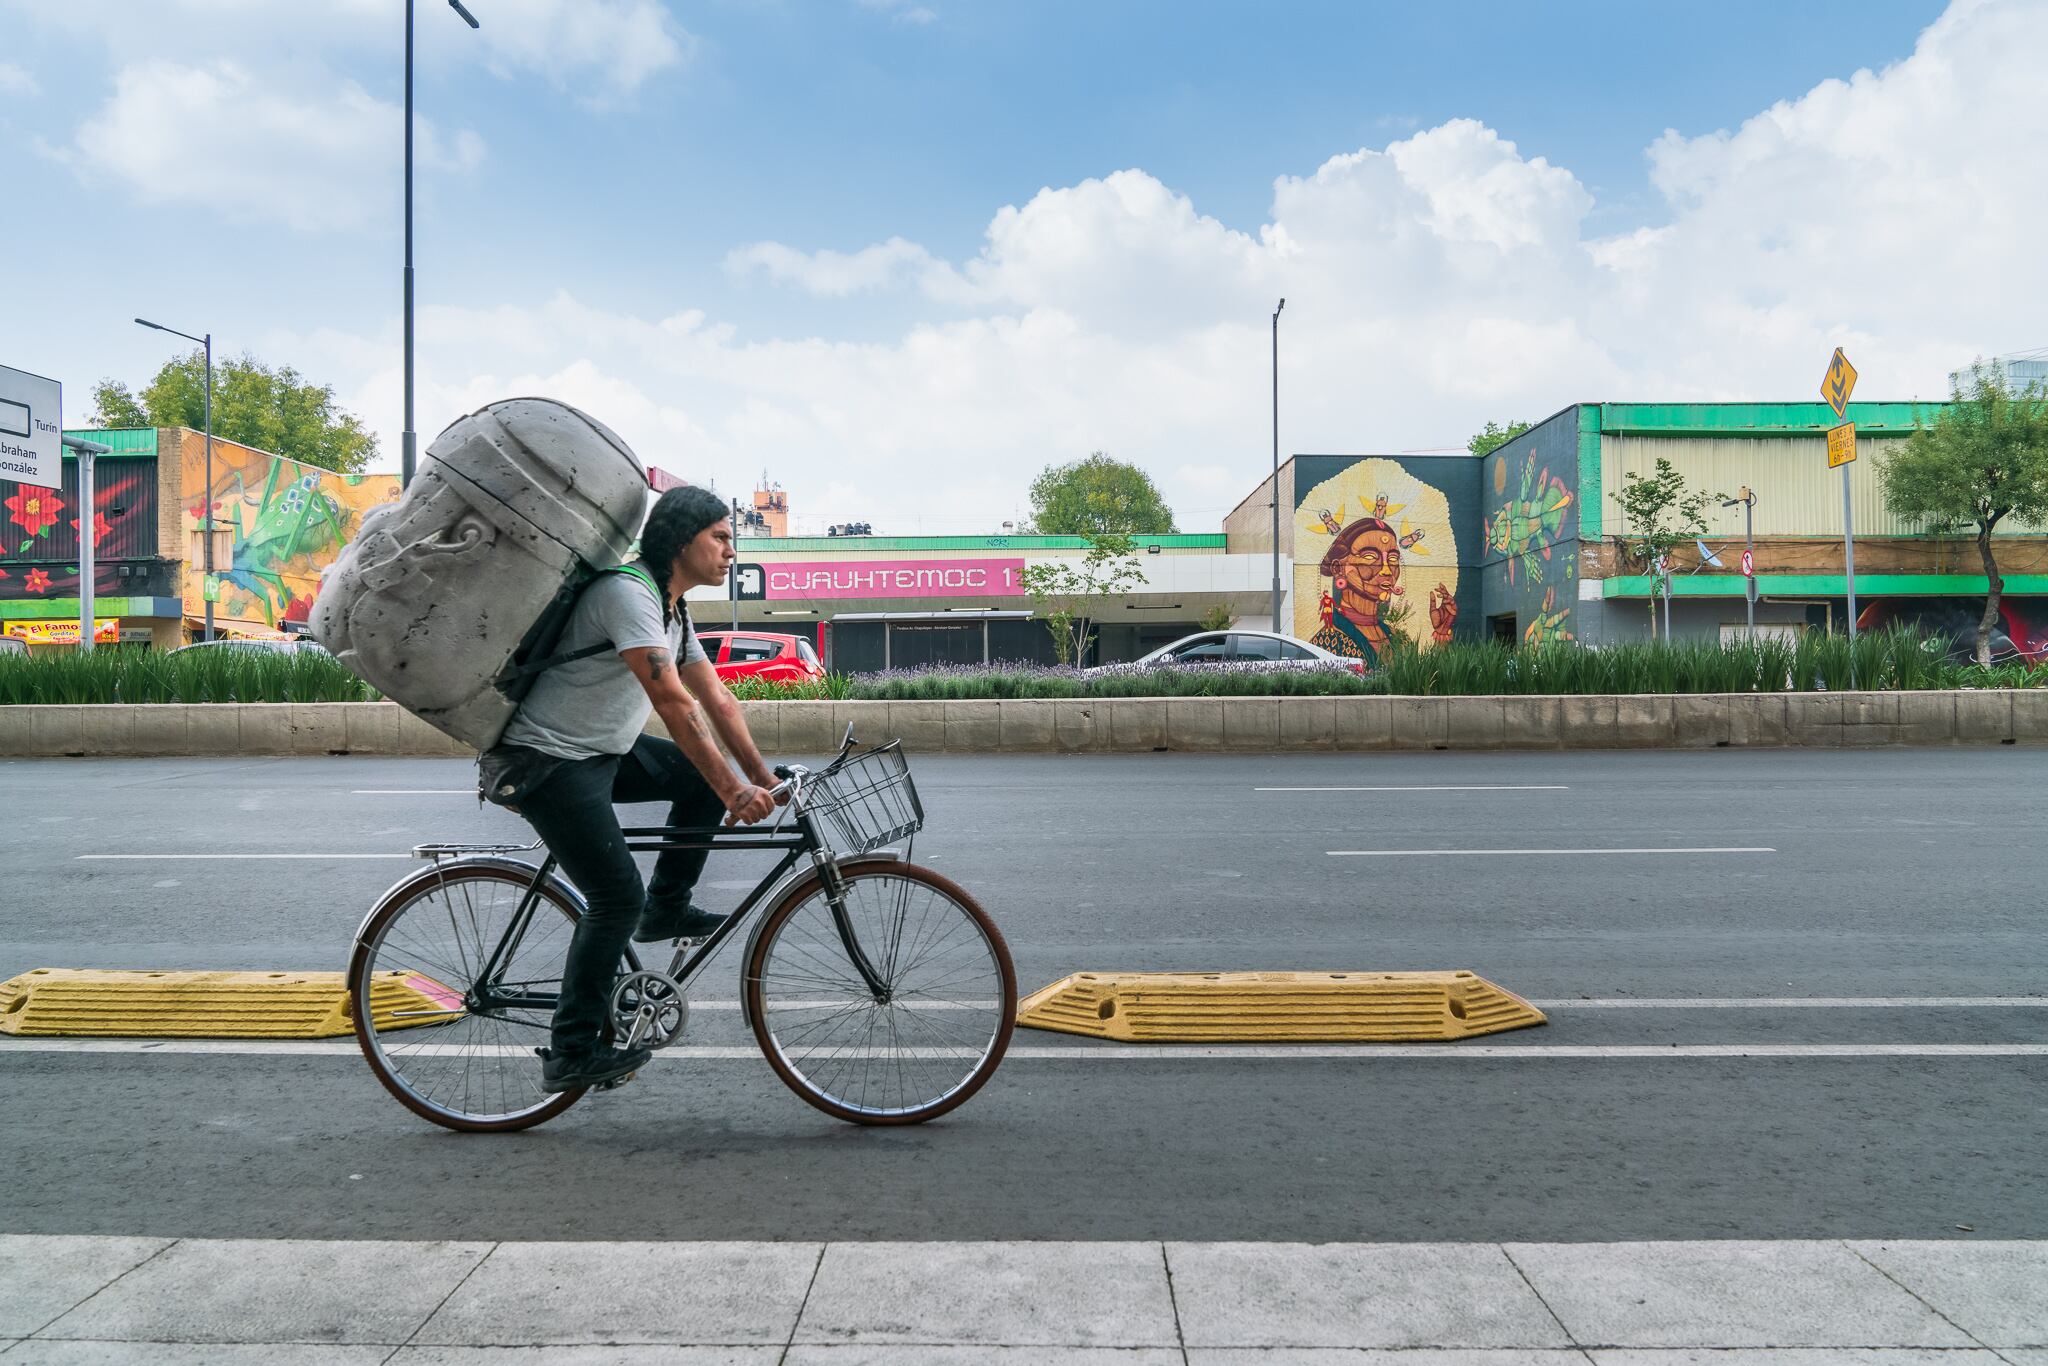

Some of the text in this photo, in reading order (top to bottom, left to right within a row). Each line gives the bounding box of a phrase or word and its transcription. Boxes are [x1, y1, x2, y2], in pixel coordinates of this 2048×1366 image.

[1829, 427, 1847, 442] LUNES
[0, 442, 37, 459] braham
[1830, 436, 1854, 453] VIERNES
[770, 567, 987, 591] CUAUHTEMOC
[30, 623, 81, 634] El Famo
